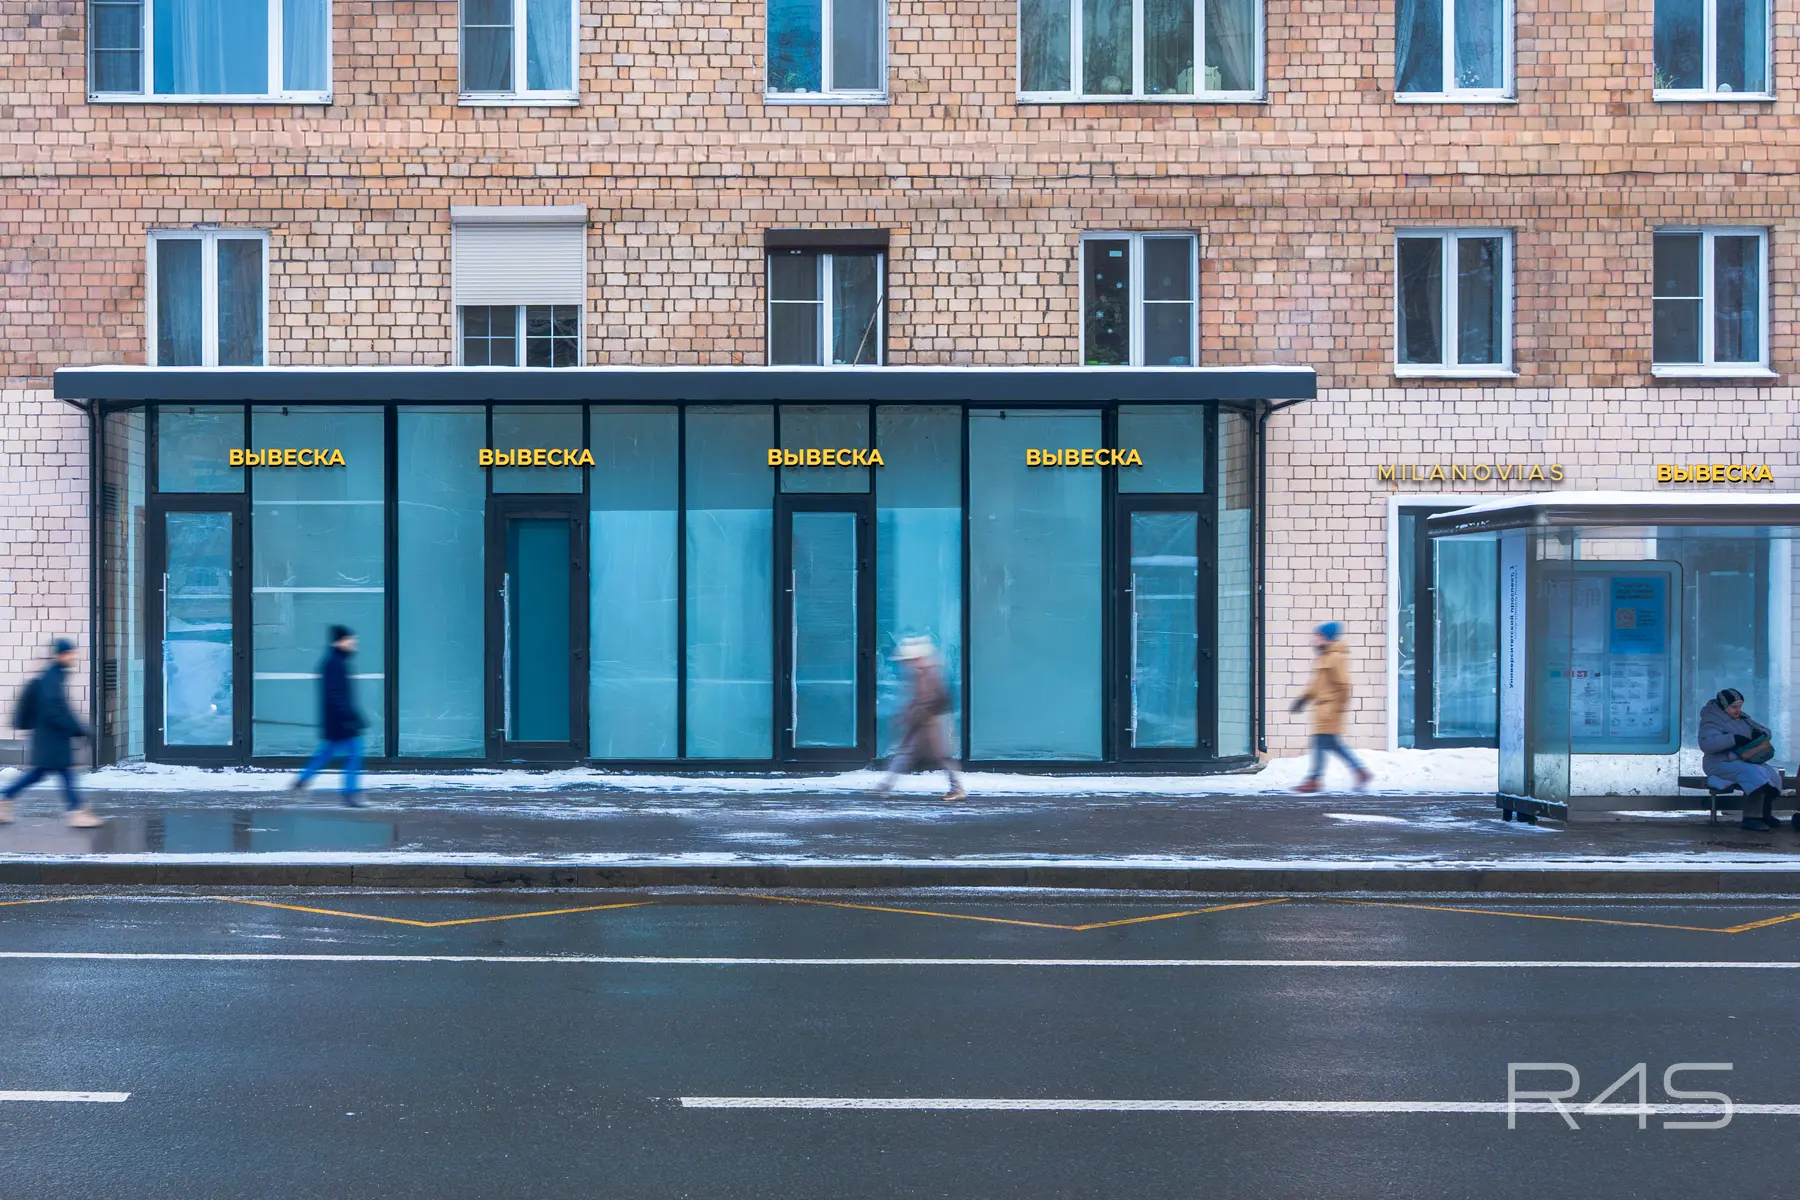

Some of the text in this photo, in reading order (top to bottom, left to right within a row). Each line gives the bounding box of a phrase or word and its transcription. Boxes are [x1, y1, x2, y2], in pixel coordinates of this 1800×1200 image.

[229, 449, 346, 467] ВЫВЕСКА
[479, 449, 596, 467] ВЫВЕСКА
[767, 449, 884, 467] ВЫВЕСКА
[1026, 449, 1143, 467] ВЫВЕСКА
[1378, 464, 1565, 483] MILANOVIAS
[1656, 464, 1774, 483] ВЫВЕСКА
